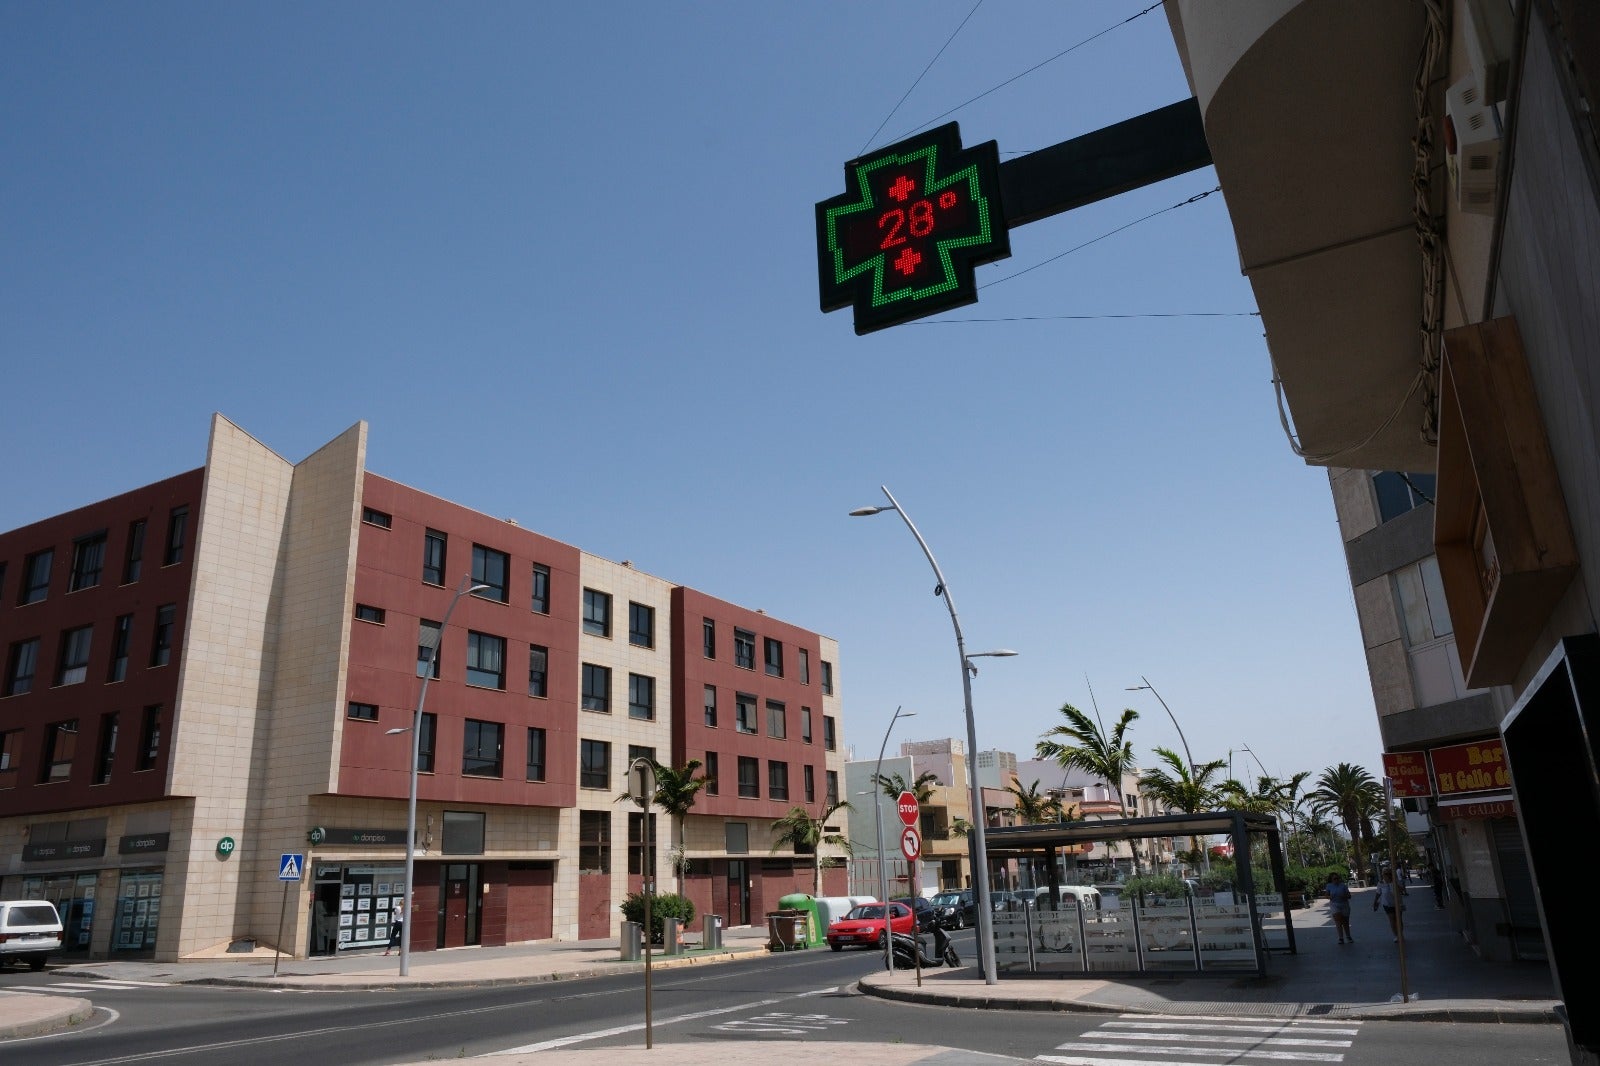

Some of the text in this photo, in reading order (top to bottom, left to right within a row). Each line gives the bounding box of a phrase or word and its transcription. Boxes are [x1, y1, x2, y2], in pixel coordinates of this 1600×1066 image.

[1466, 746, 1503, 766] Bar
[1439, 772, 1455, 792] El
[1456, 768, 1492, 790] Gallo
[900, 804, 917, 814] STOP
[1449, 807, 1463, 817] EL
[1468, 802, 1505, 816] GALLO
[311, 831, 321, 842] dp
[361, 833, 386, 842] donpiso
[220, 840, 233, 852] dp
